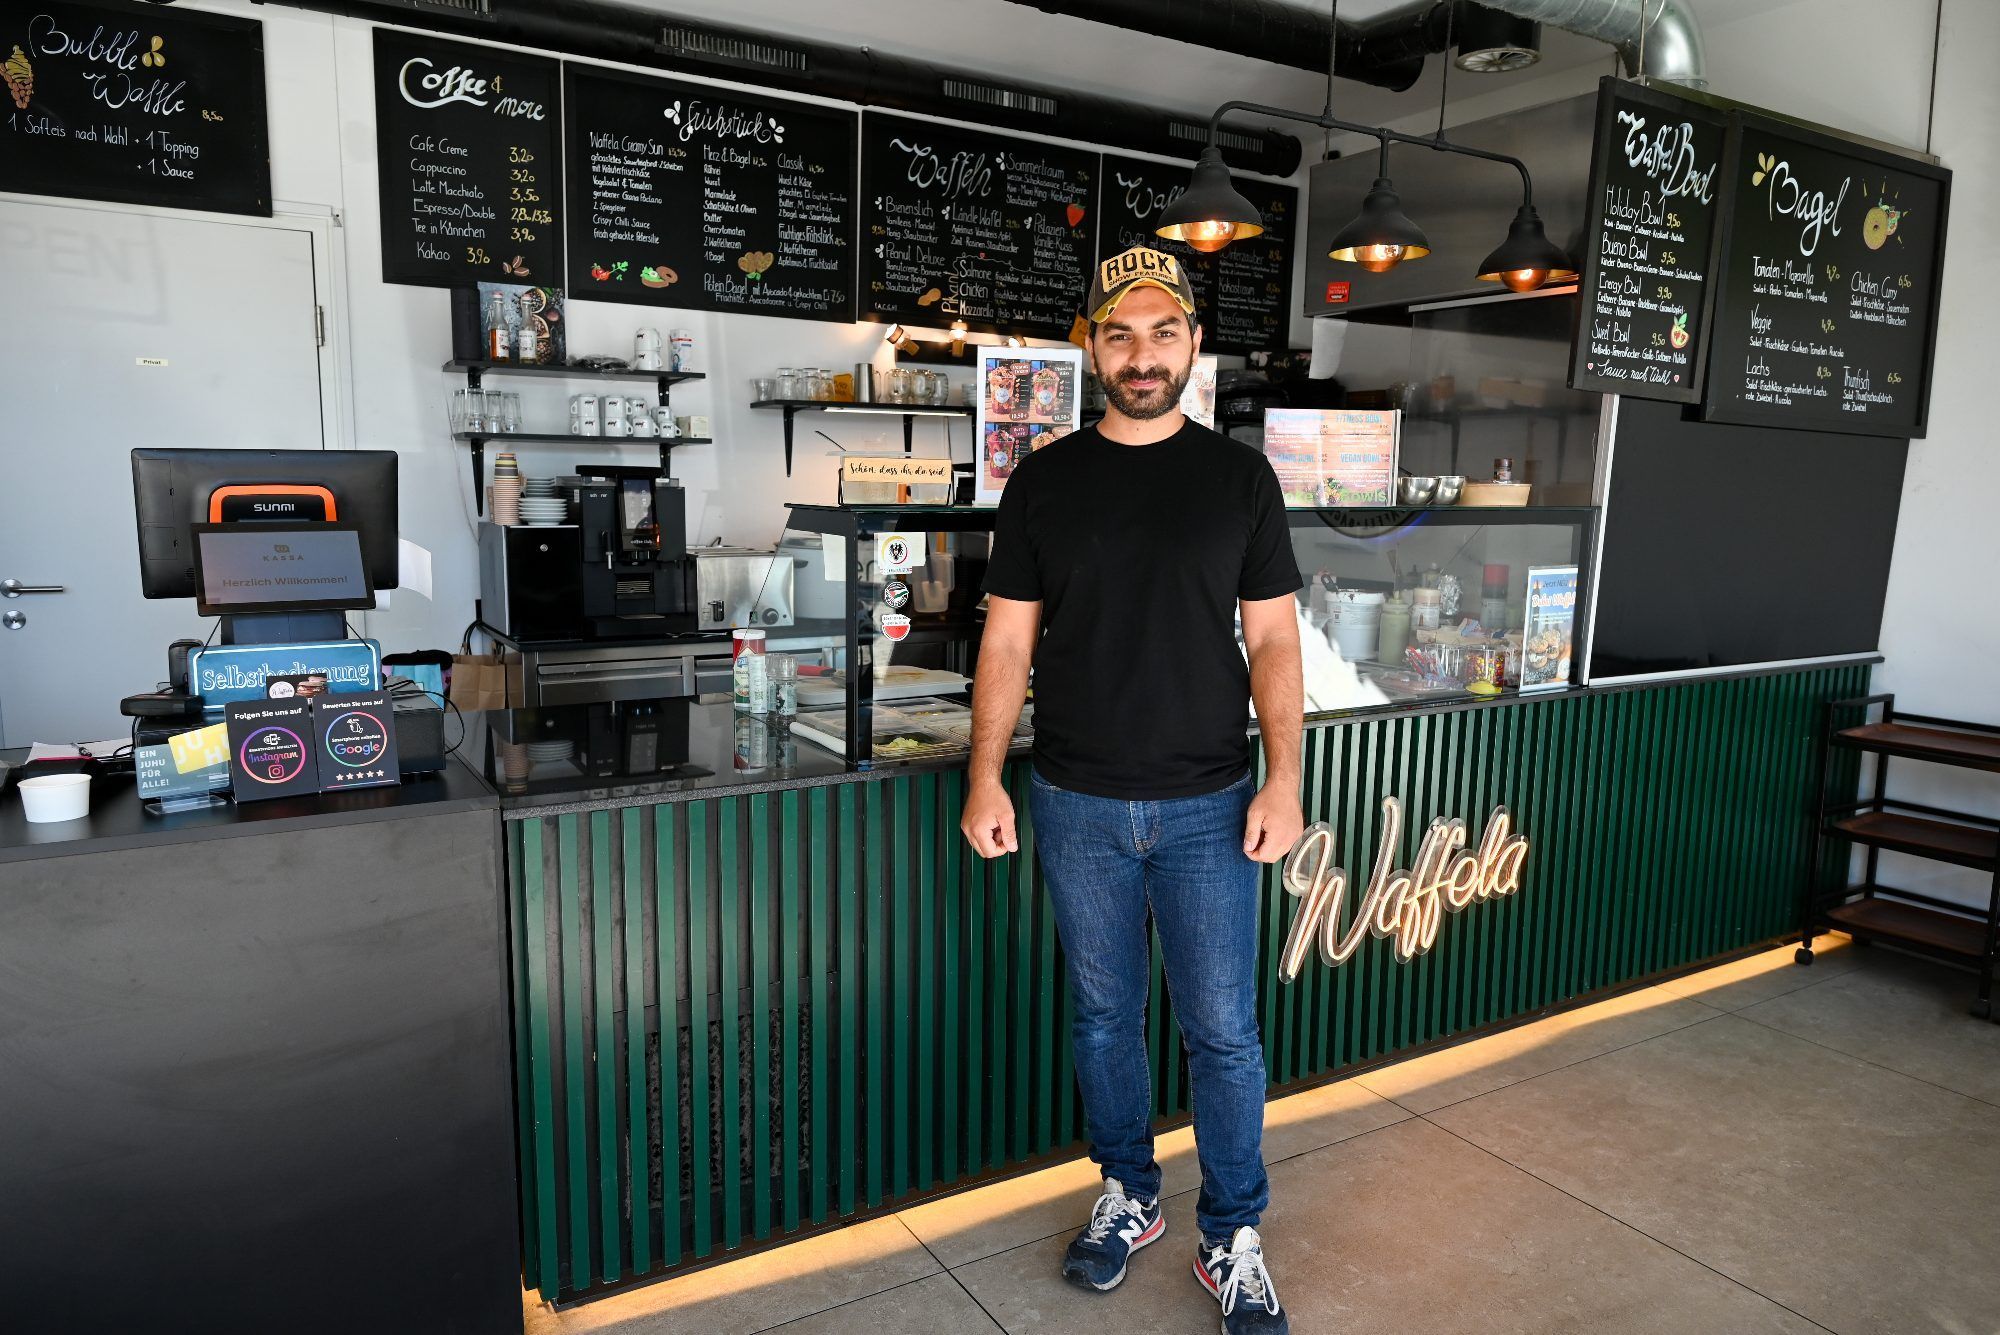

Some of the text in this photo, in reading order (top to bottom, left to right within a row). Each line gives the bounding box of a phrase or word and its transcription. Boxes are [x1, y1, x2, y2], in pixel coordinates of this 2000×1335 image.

[29, 15, 137, 70] Bubble
[399, 57, 488, 108] Coffee
[202, 109, 223, 122] 8,50
[493, 96, 545, 121] more
[679, 101, 772, 143] Frühstück
[25, 115, 66, 137] Softeis
[75, 125, 97, 141] nach
[104, 125, 128, 146] Wahl
[158, 131, 199, 159] Topping
[590, 132, 619, 150] Waffela
[649, 139, 663, 155] Sun
[410, 135, 534, 162] Cafe Creme 3,20
[704, 144, 720, 161] Herz
[730, 148, 751, 169] Bagel
[1618, 110, 1716, 205] Waffel Bowl
[162, 159, 194, 180] Sauce
[410, 158, 535, 182] Cappuccino 3,20
[889, 138, 991, 199] Waffeln
[1006, 152, 1065, 179] Sommertraum
[412, 178, 540, 202] Latte Macchiato 3,50
[628, 179, 652, 190] Tomaten
[704, 188, 736, 201] Marmelade
[413, 199, 495, 220] Espresso/Double
[1605, 184, 1681, 228] Holiday Bowl 9,50
[1769, 161, 1851, 257] Bagel
[412, 218, 426, 233] Tee
[431, 223, 437, 234] in
[511, 227, 535, 242] 3,90
[593, 214, 650, 229] Crispy Sauce
[704, 225, 745, 237] Cherrytomaten
[417, 241, 490, 264] Kakao 3,90
[709, 252, 725, 263] Bagel
[886, 242, 946, 266] Peanut Deluxe
[1601, 232, 1676, 264] Bueno Bowl 9,50
[960, 260, 992, 280] Salmone
[1107, 252, 1172, 281] ROCK
[1617, 259, 1674, 277] Bueno Banane
[1753, 256, 1840, 282] Tomaten 4,90
[726, 274, 748, 295] Bagel
[960, 282, 988, 298] Chicken
[1109, 273, 1131, 287] SHOW
[1599, 272, 1672, 299] Energy Bowl 9,90
[1851, 271, 1911, 300] Chicken Curry 6,50
[1619, 295, 1635, 307] Banane
[1753, 284, 1803, 299] Salat Pesto Tomaten
[960, 300, 994, 317] Mozzarella
[1751, 303, 1835, 334] Veggie 4,90
[1592, 319, 1666, 346] Sweet Bowl 9,50
[1749, 336, 1844, 357] Salat Gurken Tomaten Rucola
[1630, 365, 1672, 385] nach Wahl
[1746, 354, 1831, 379] Lachs 8,90
[1746, 378, 1758, 389] Salat
[1843, 366, 1901, 391] Thunfisch 6,50
[262, 554, 304, 562] KASSA
[223, 576, 348, 588] Herzlich Willkommen!
[235, 712, 260, 720] Folgen
[140, 750, 156, 758] EIN
[249, 751, 298, 763] Instagram
[334, 741, 380, 756] Google
[140, 759, 165, 768] JUHU
[141, 769, 160, 778] FÜR
[142, 779, 169, 788] ALLE!
[1285, 798, 1528, 980] Waffela
